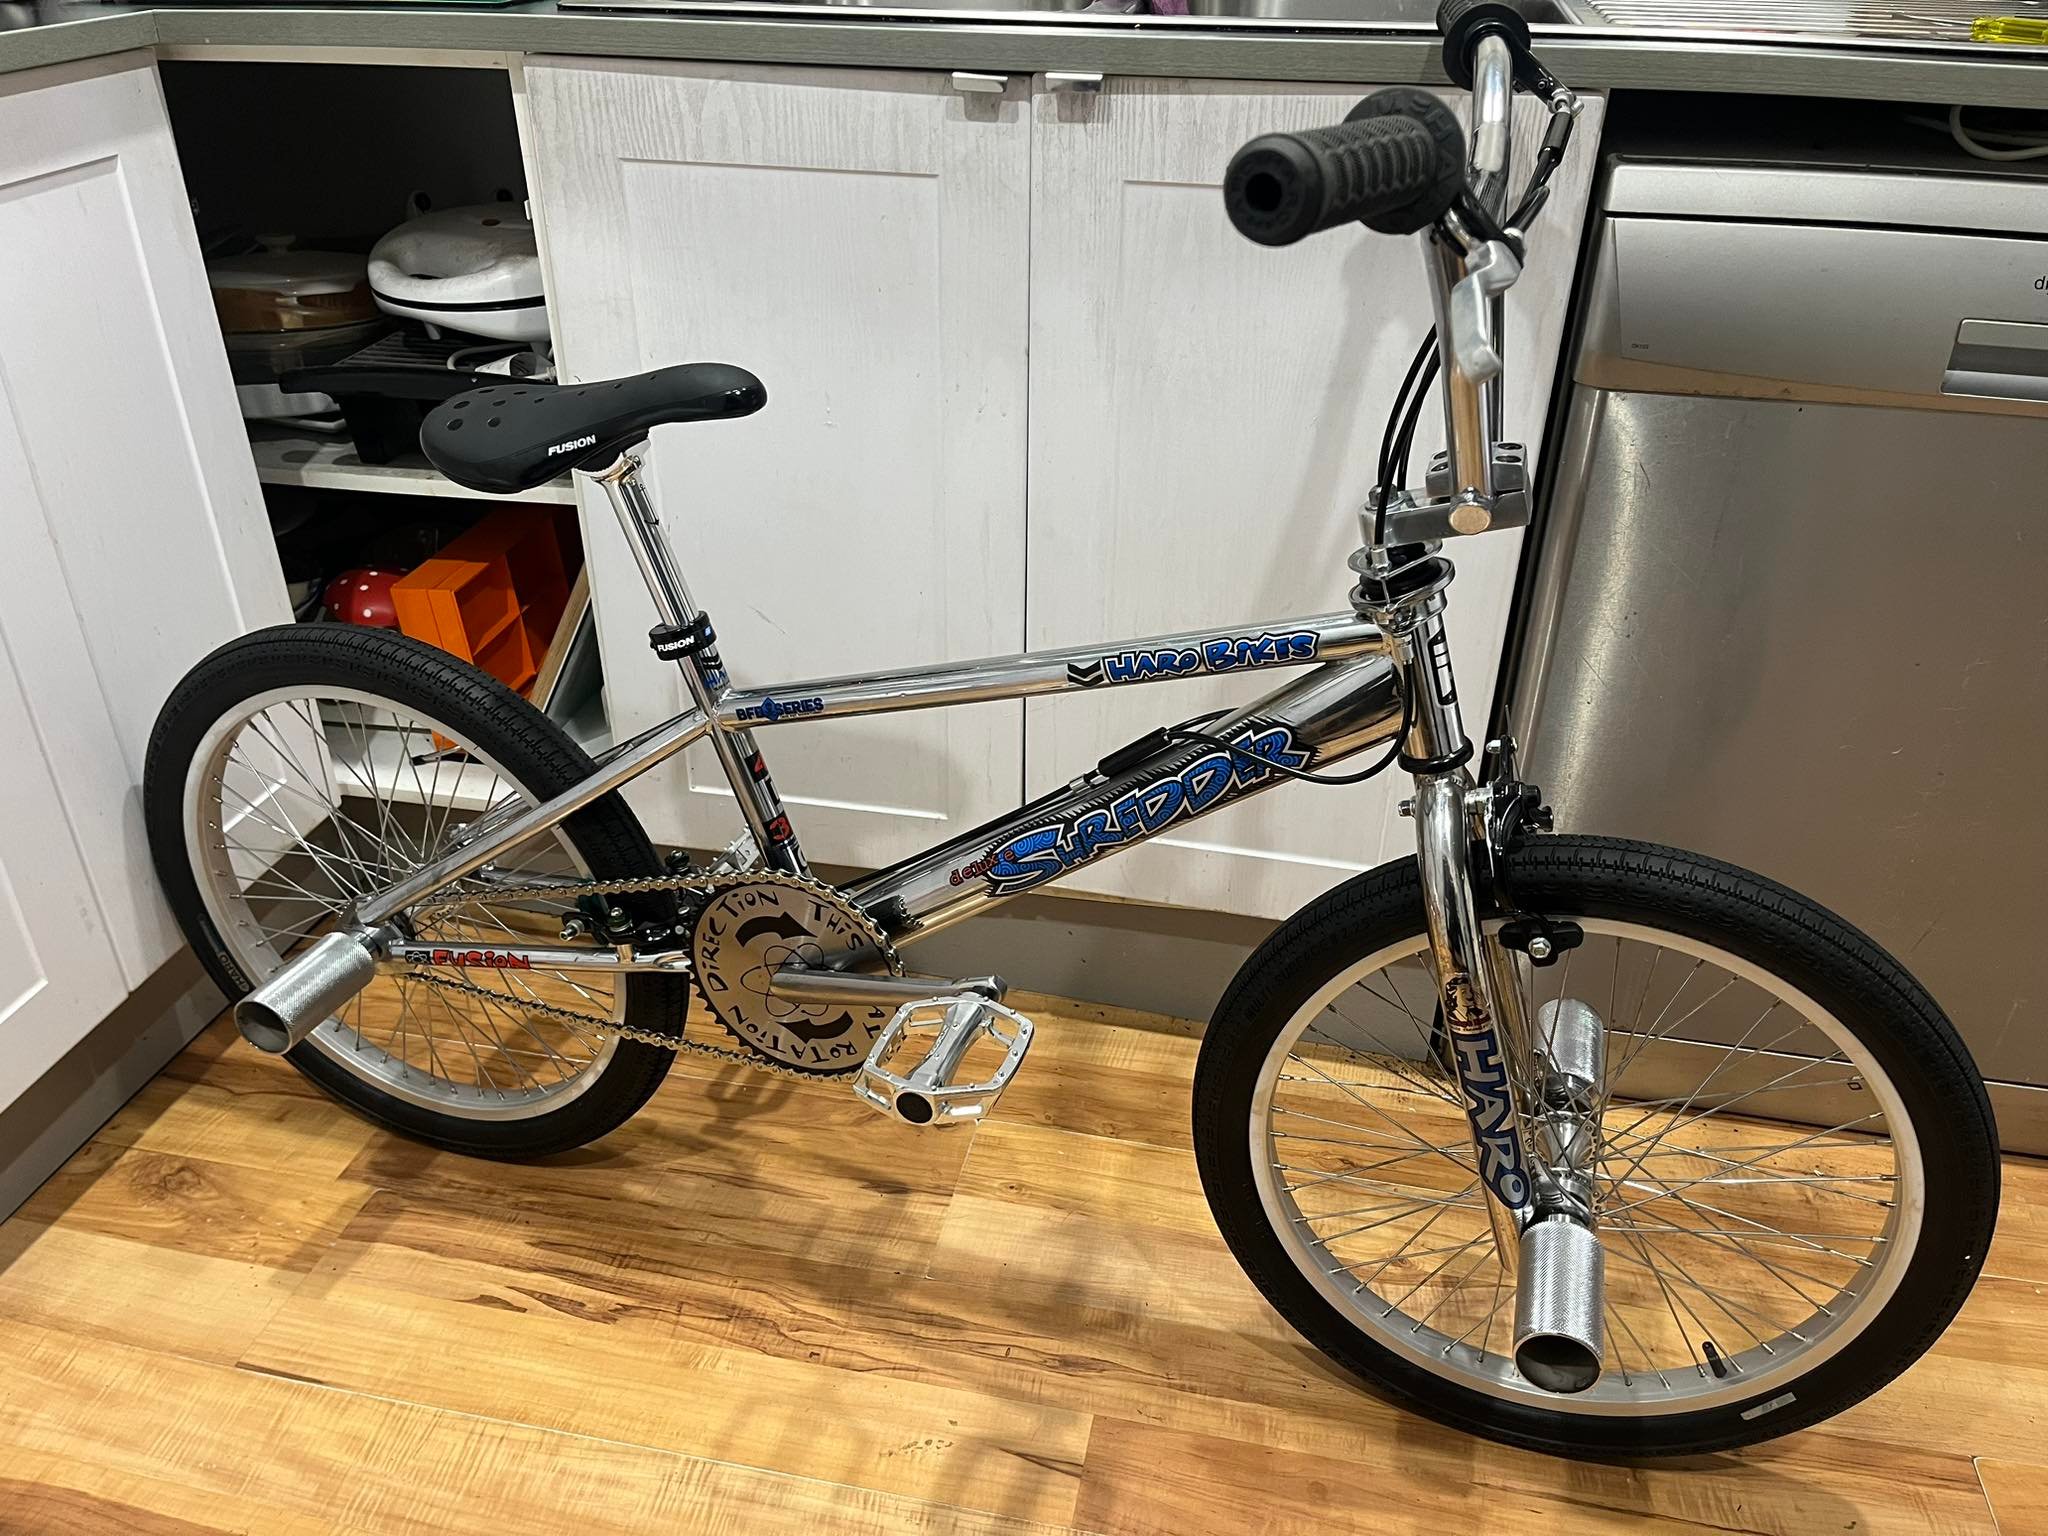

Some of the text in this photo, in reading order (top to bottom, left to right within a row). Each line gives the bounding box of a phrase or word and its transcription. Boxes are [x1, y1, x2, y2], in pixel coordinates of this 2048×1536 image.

[547, 434, 597, 456] FUSION
[657, 635, 695, 653] FUSION
[1103, 649, 1200, 683] HARO
[775, 697, 825, 715] SERIES
[988, 727, 1310, 895] SHREDDER
[950, 849, 1015, 886] deluxe
[863, 1005, 886, 1039] AY
[1454, 1035, 1528, 1207] HARO
